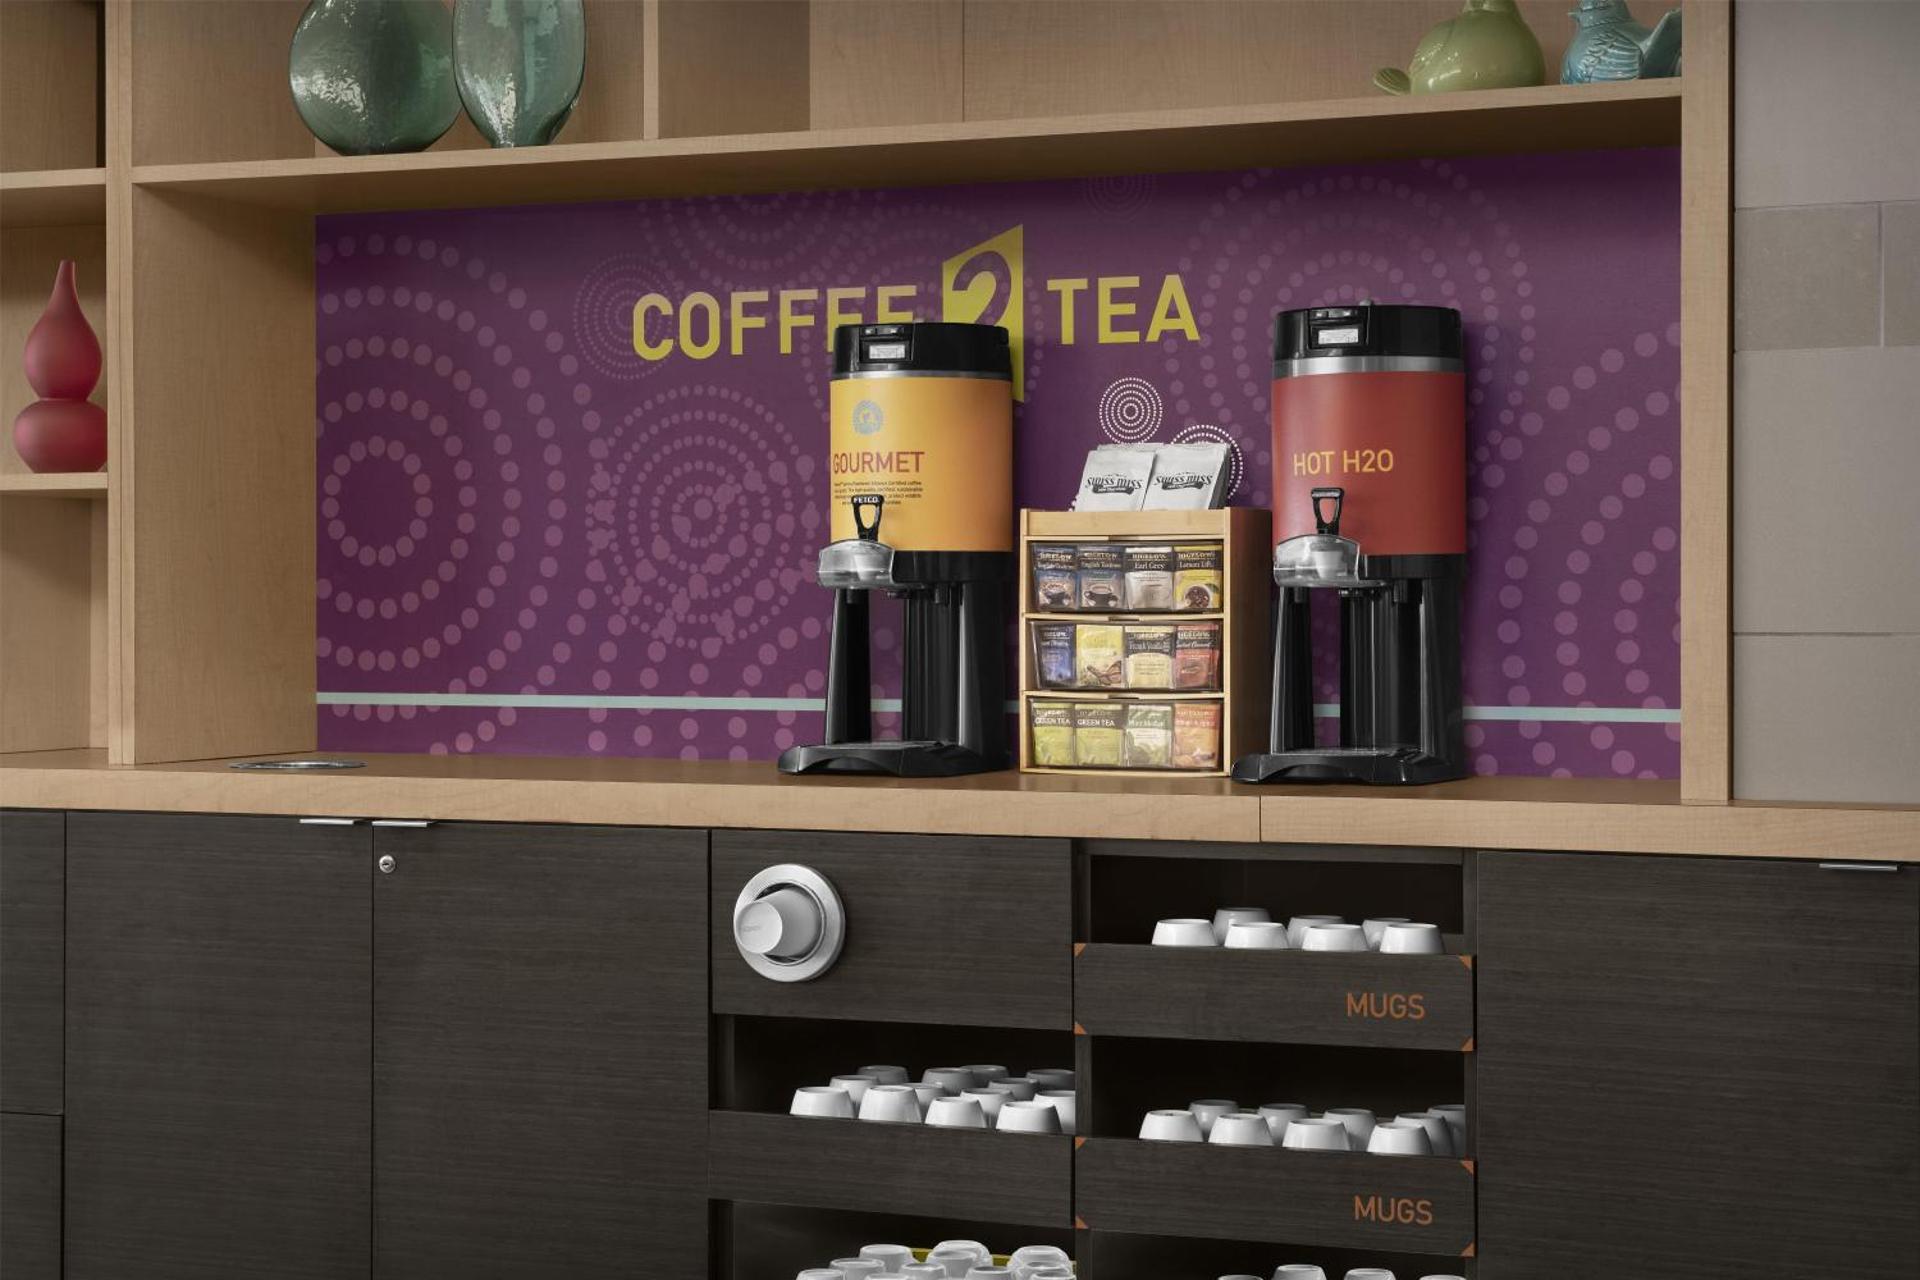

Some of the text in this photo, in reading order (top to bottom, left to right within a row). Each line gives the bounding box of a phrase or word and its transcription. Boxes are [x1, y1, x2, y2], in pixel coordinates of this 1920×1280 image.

[1047, 274, 1200, 345] TEA
[832, 451, 925, 474] GOURMET
[1293, 451, 1335, 476] HOT
[1034, 717, 1055, 725] GREEN
[1077, 718, 1101, 727] GREEN
[1347, 992, 1426, 1020] MUGS
[1354, 1195, 1433, 1226] MUGS
